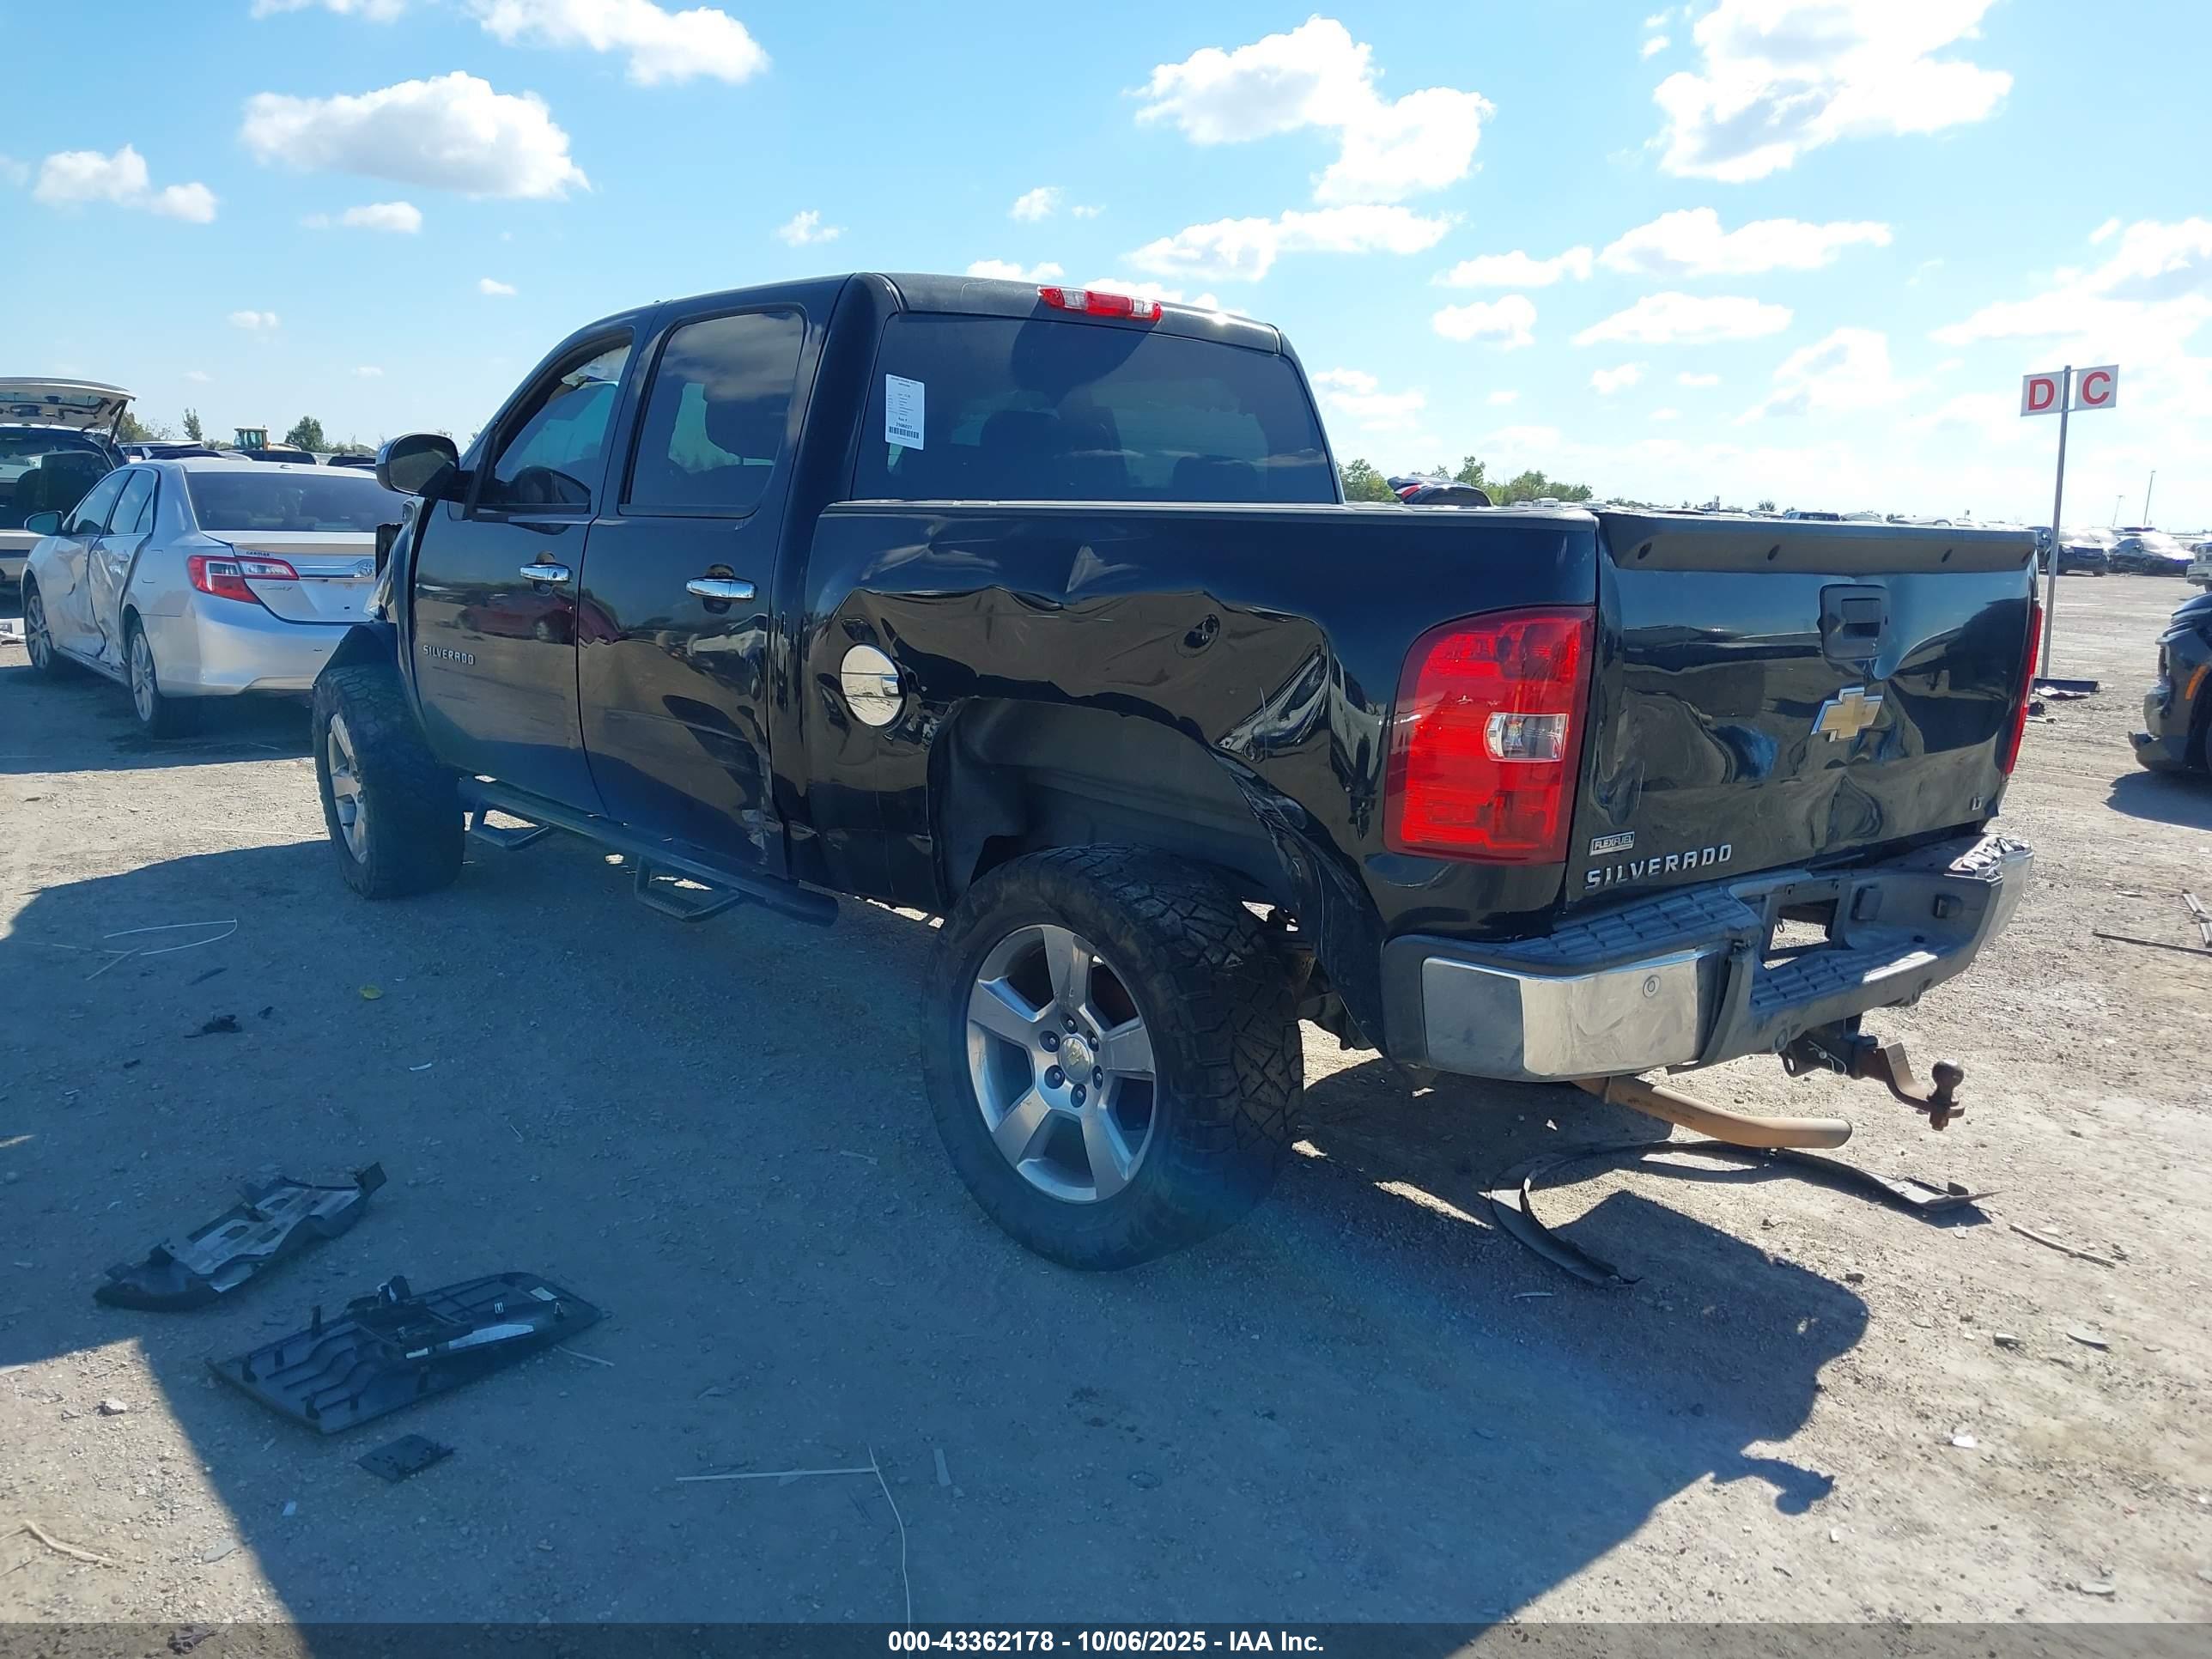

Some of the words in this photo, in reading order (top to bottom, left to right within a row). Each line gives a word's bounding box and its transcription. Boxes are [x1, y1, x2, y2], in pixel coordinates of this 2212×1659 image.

[2028, 379, 2055, 411] D
[2082, 371, 2111, 405] C
[422, 644, 475, 665] SILVERADO
[1593, 834, 1633, 851] FLEXFUEL
[1584, 844, 1733, 890] SILVERADO
